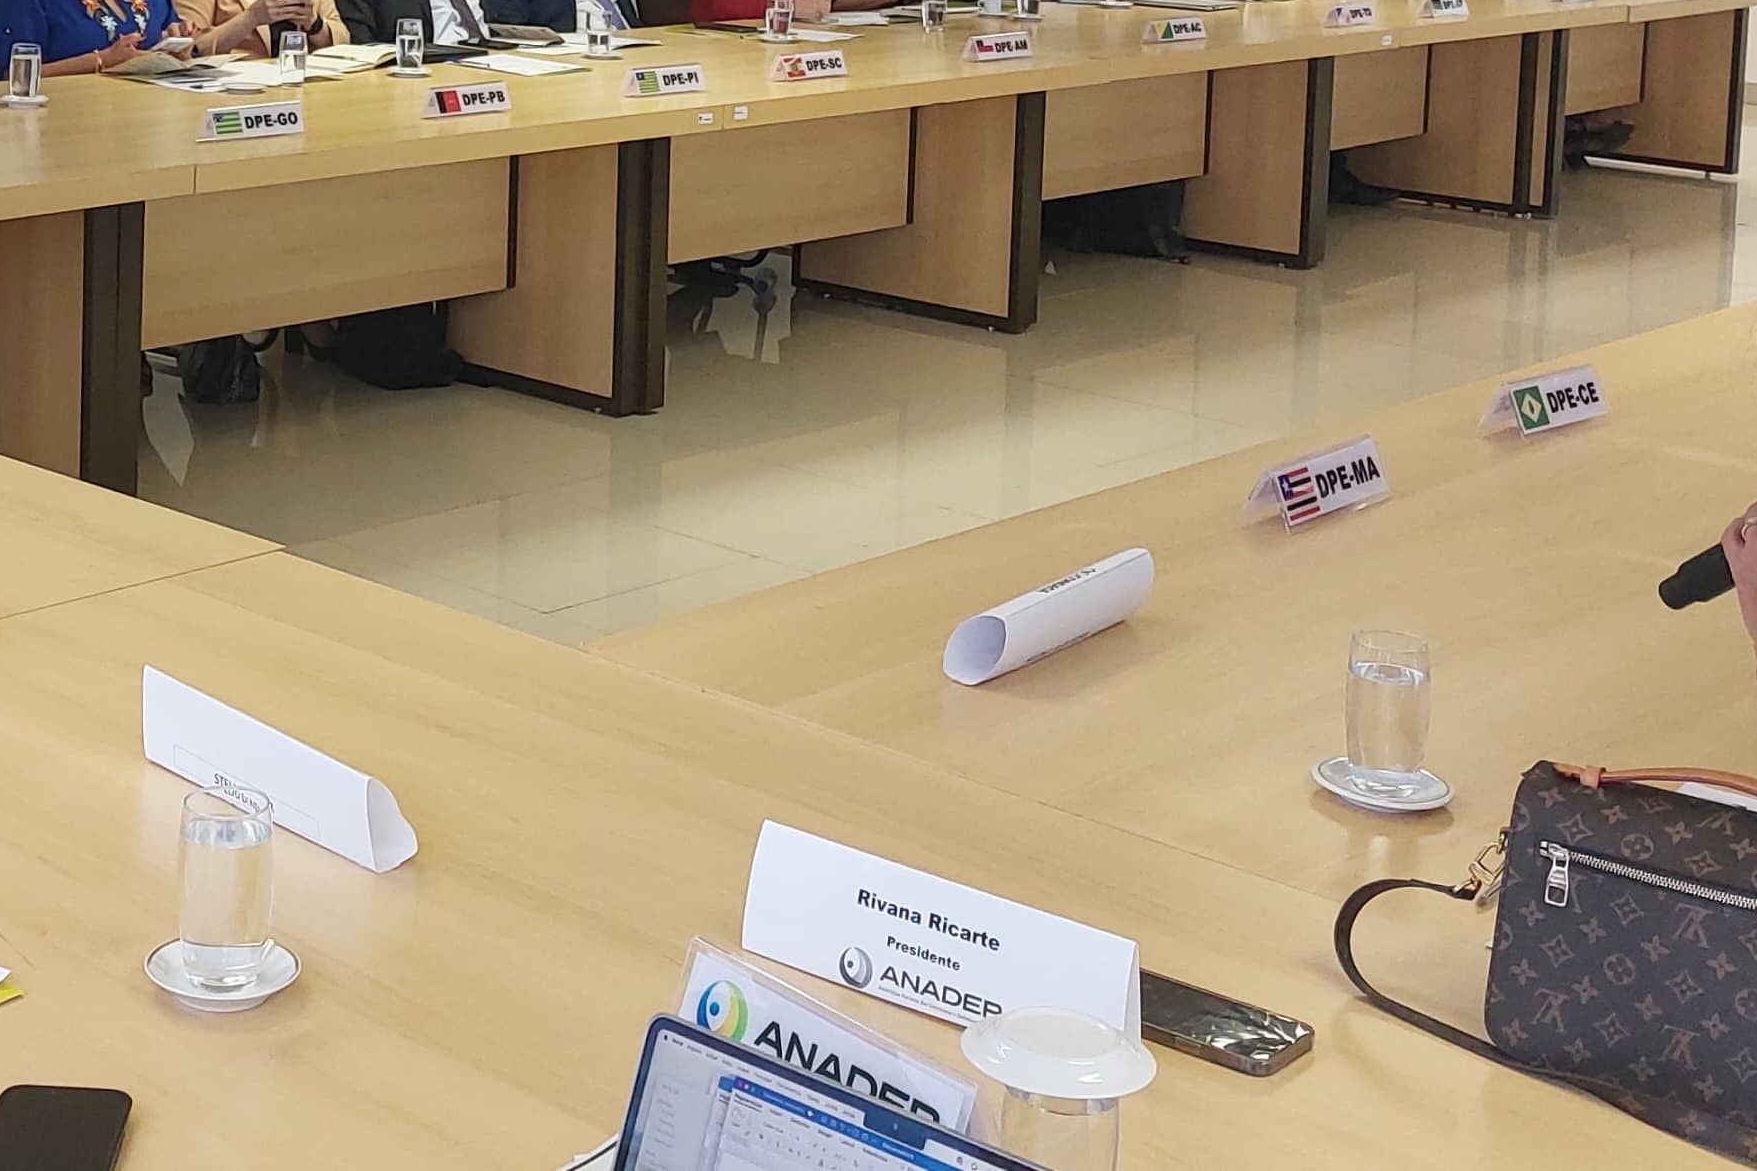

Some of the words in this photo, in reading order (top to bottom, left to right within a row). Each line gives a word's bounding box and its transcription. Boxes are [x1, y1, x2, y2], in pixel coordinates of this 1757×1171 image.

[661, 71, 700, 87] DPE-PI
[805, 56, 843, 72] DPE-SC
[462, 89, 506, 107] DPE-PB
[243, 111, 299, 130] DPE-GO
[1545, 381, 1600, 415] DPE-CE
[1315, 454, 1381, 500] DPE-MA
[857, 887, 922, 925] Rivana
[928, 911, 1001, 952] Ricarte
[886, 935, 961, 972] Presidente
[879, 965, 1003, 1018] ANADEP
